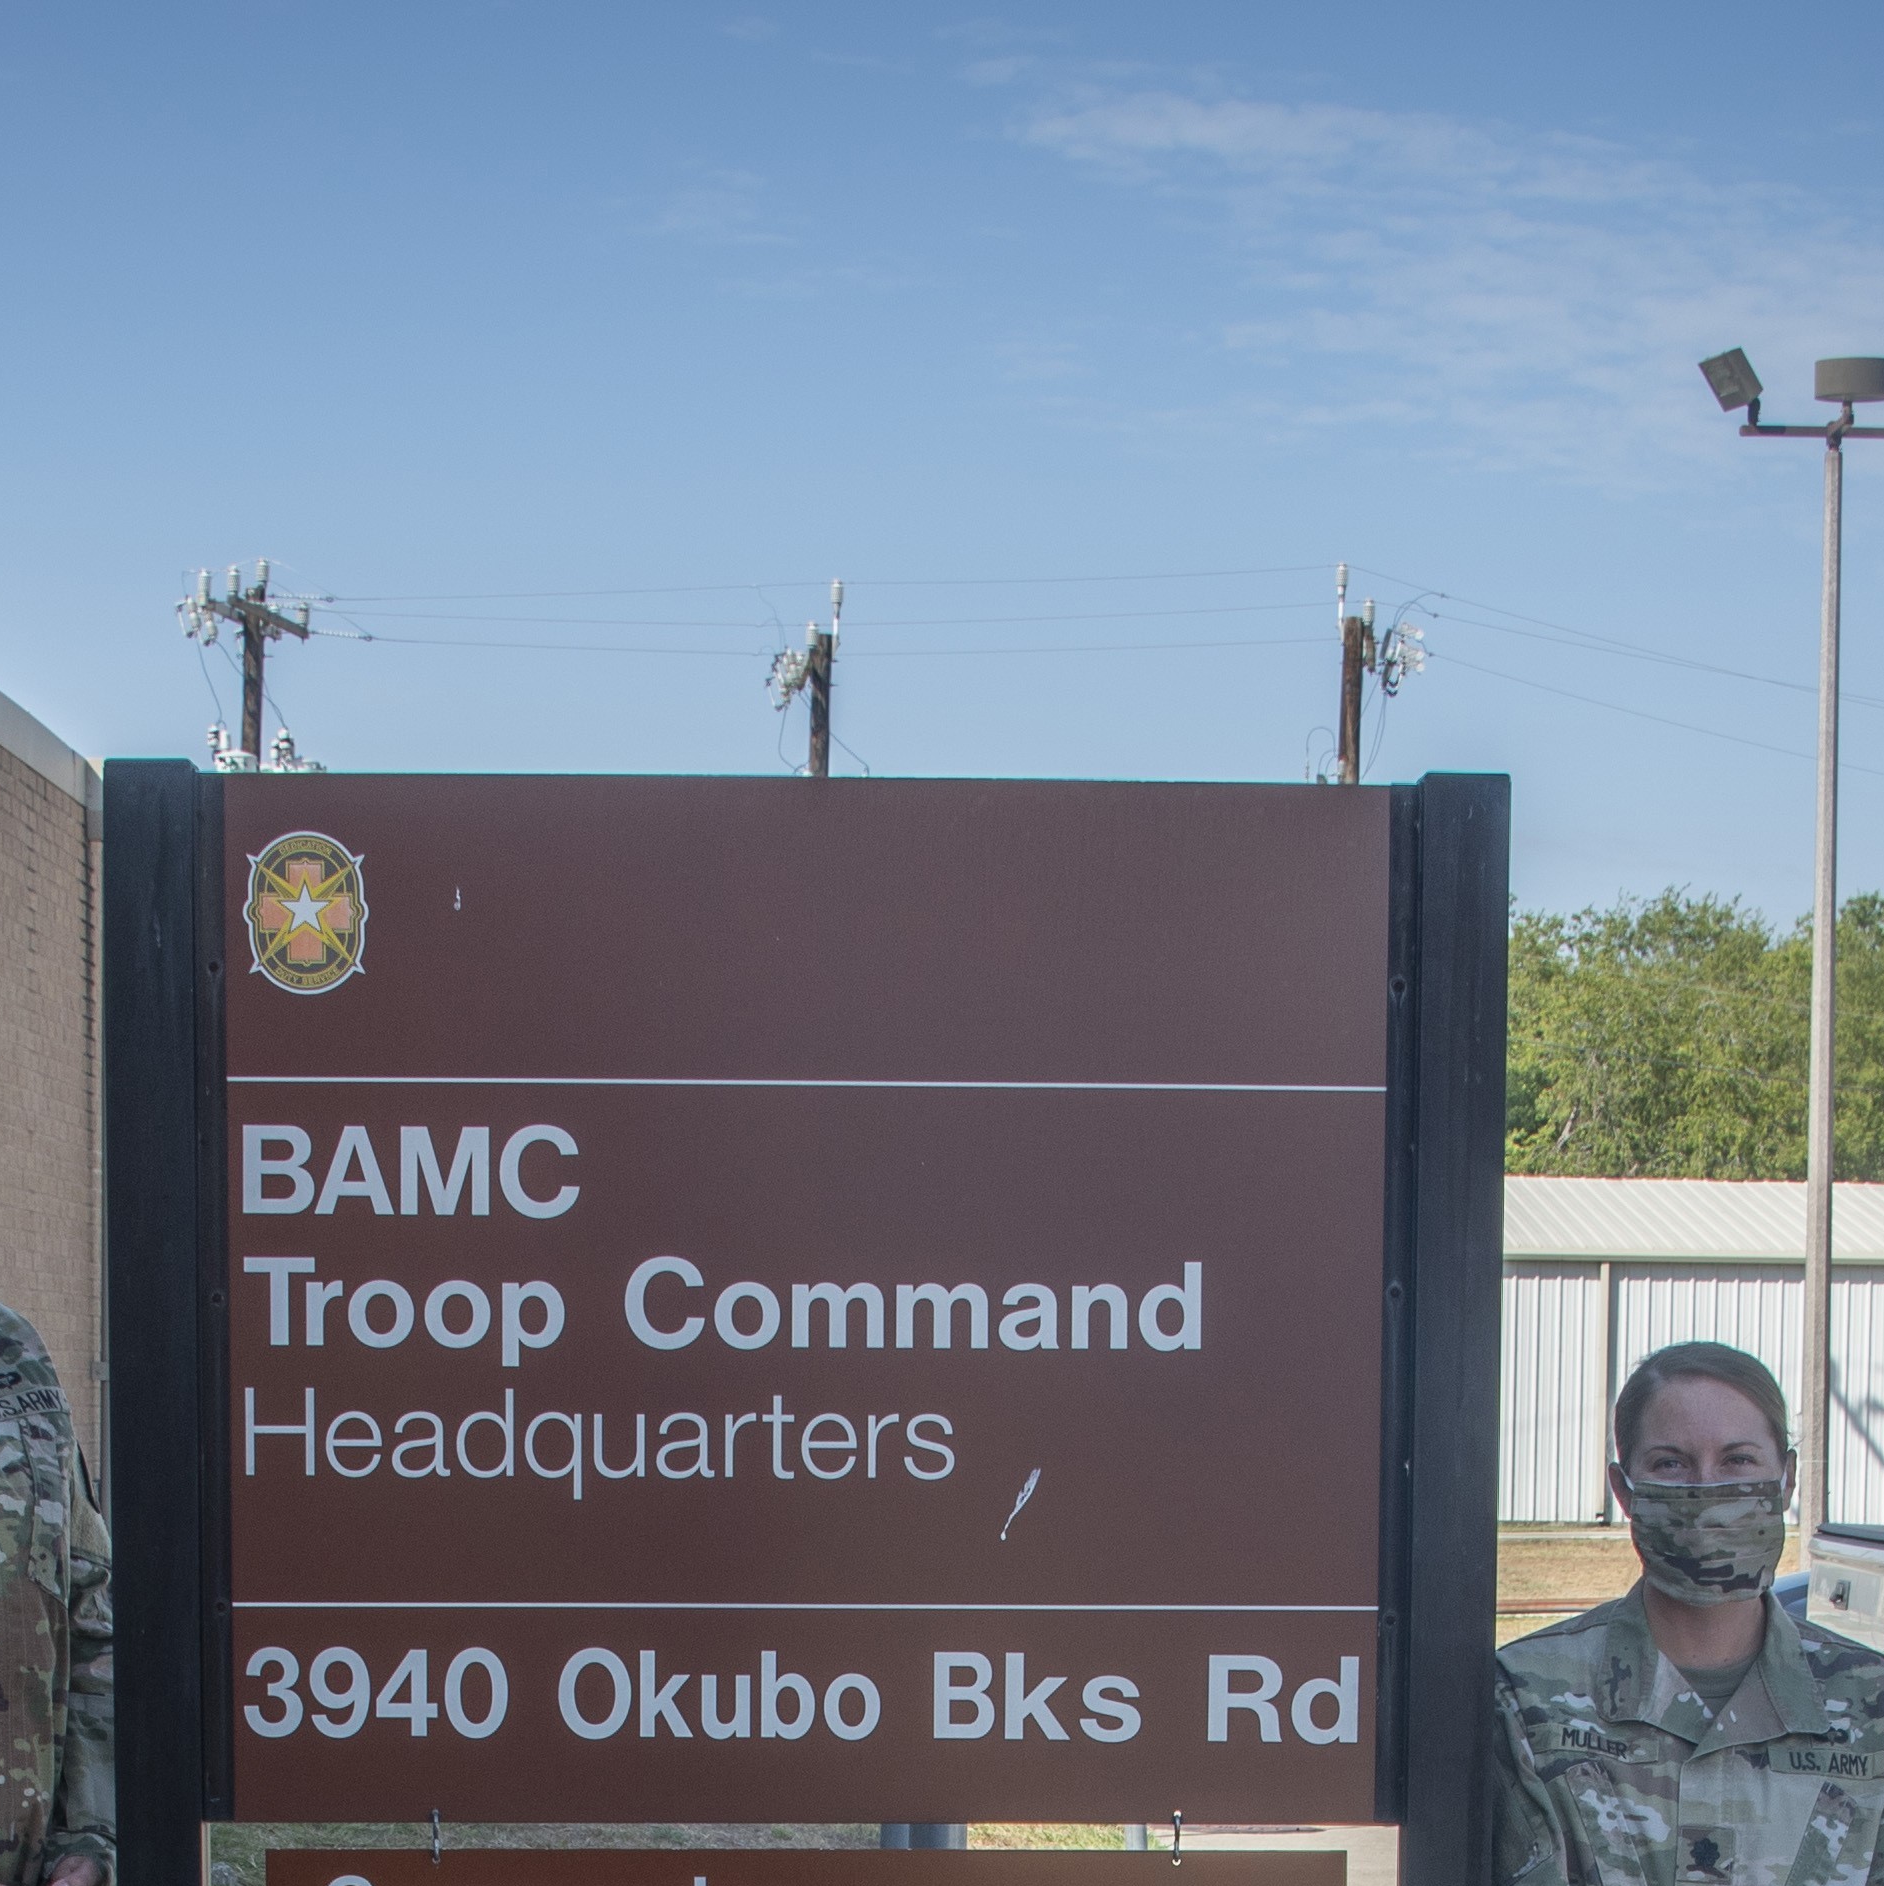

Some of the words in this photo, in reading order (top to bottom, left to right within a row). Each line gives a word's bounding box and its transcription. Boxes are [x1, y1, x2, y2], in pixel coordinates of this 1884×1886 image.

[243, 1123, 579, 1219] BAMC
[243, 1256, 565, 1367] Troop
[624, 1255, 1203, 1352] Command
[244, 1387, 956, 1501] Headquarters
[243, 1646, 509, 1739] 3940
[558, 1647, 881, 1741] Okubo
[932, 1651, 1142, 1743] Bks
[1206, 1653, 1360, 1745] Rd
[1561, 1727, 1629, 1760] MULLER
[1790, 1751, 1821, 1772] U.S.
[1827, 1755, 1868, 1777] ARMY
